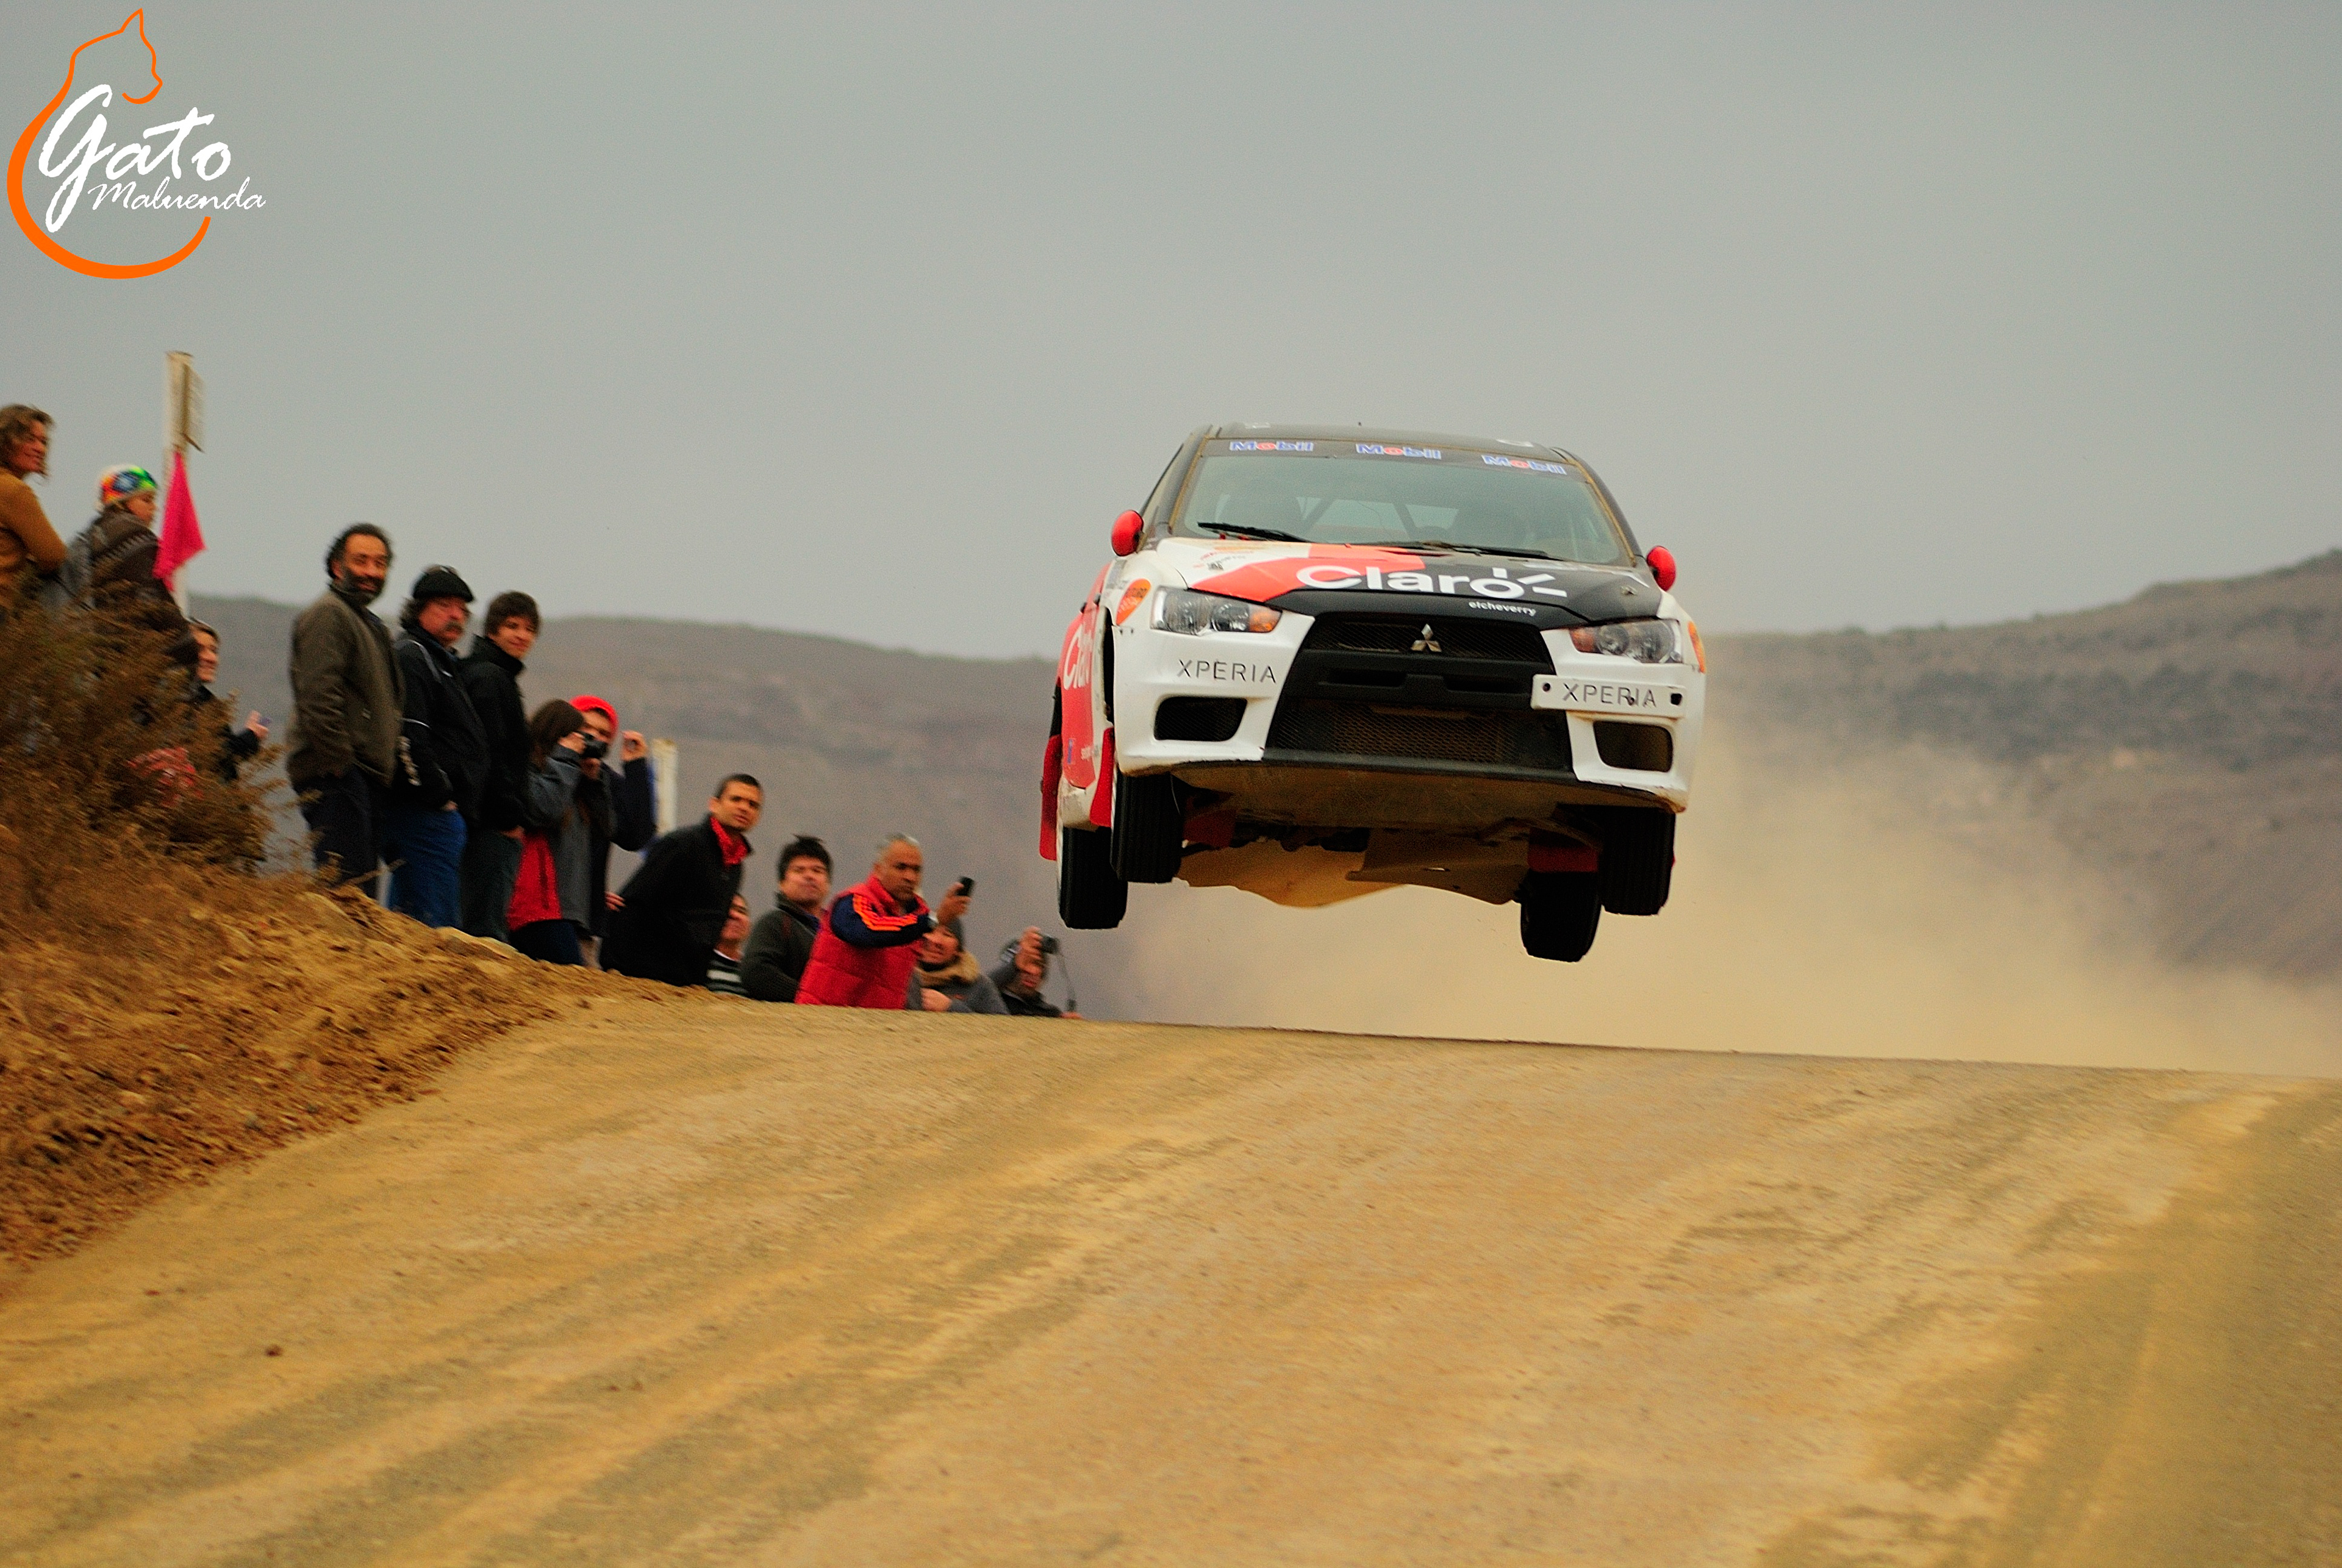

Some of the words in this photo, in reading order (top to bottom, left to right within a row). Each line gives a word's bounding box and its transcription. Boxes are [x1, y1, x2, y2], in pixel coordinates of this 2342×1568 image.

[1229, 440, 1314, 453] Mobil
[1356, 443, 1441, 460] Mobil
[1481, 454, 1567, 475] Mobil
[1295, 565, 1524, 600] Claro
[1468, 601, 1536, 617] etcheverry
[1176, 659, 1277, 684] XPERIA
[1562, 682, 1657, 708] XPERIA
